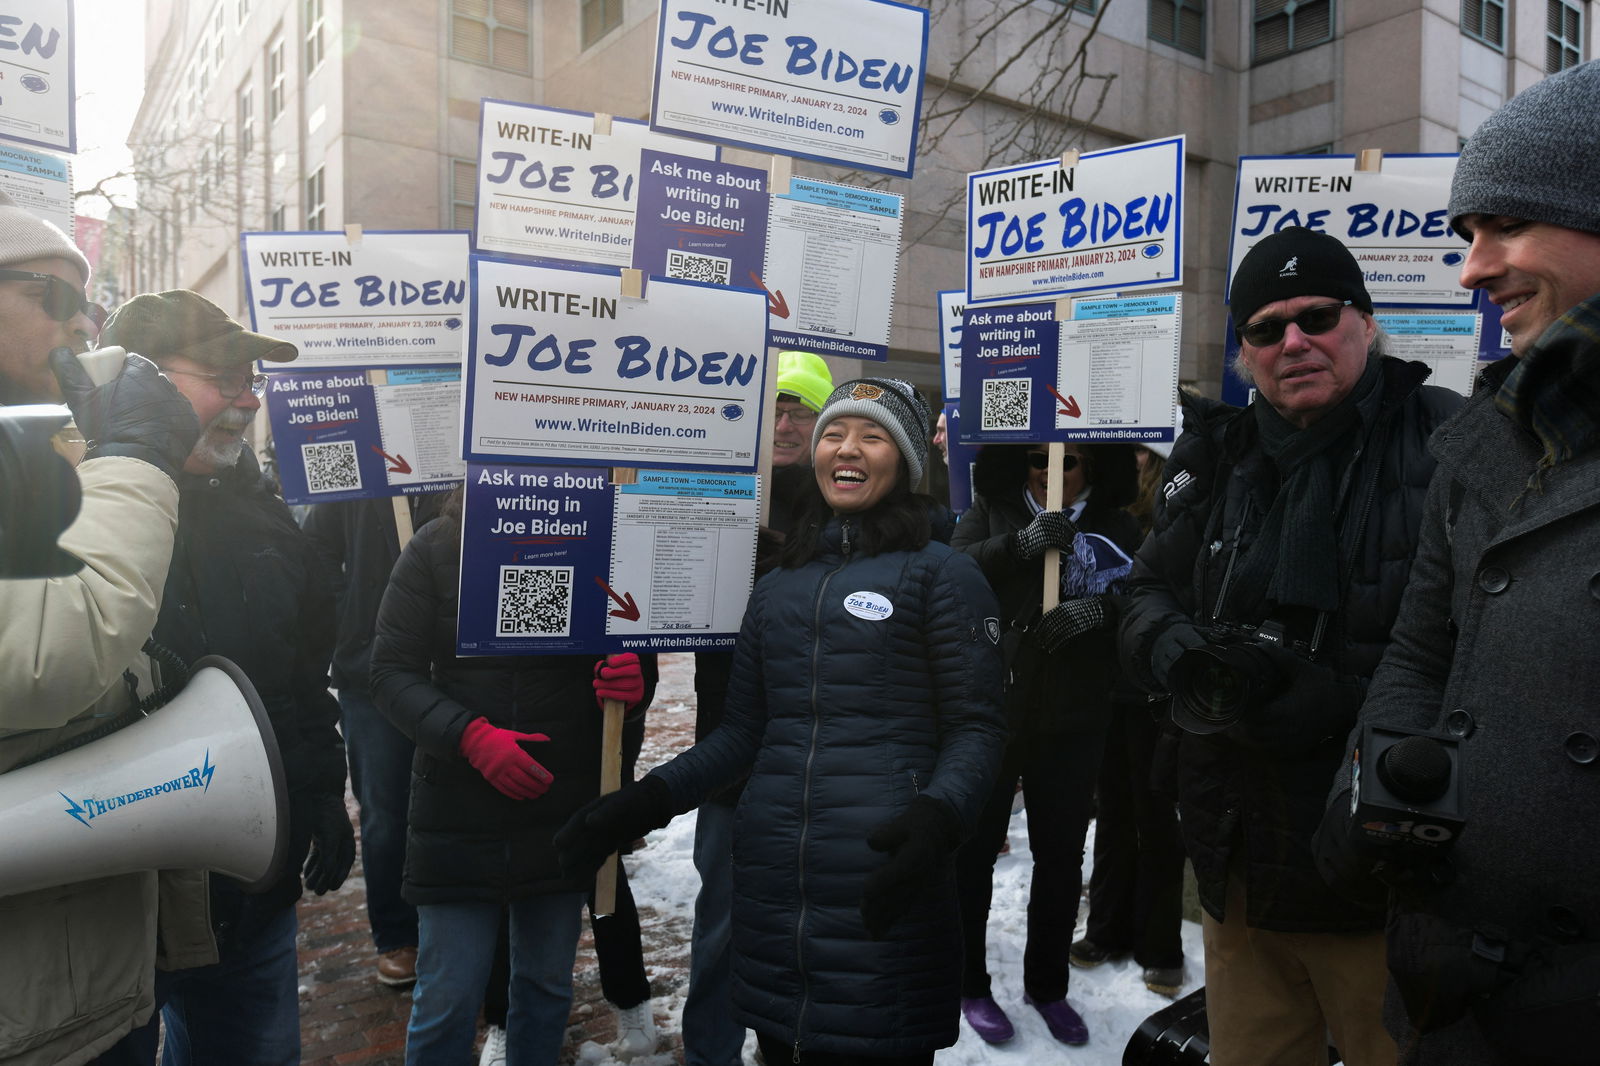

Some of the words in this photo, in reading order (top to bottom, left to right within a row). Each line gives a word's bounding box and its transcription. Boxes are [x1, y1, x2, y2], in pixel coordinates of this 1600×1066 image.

[671, 11, 769, 65] JOE
[785, 36, 913, 94] BIDEN
[671, 70, 692, 83] NEW
[694, 74, 746, 93] HAMPSHIRE
[748, 86, 789, 103] PRIMARY,
[791, 95, 831, 111] JANUARY
[833, 103, 846, 115] 23,
[848, 106, 868, 117] 2024
[712, 101, 865, 139] www.WriteInBiden.com
[498, 121, 592, 150] WRITE-IN
[0, 150, 42, 164] MOCRATIC
[487, 152, 574, 193] JOE
[651, 160, 682, 178] Ask
[687, 168, 712, 183] me
[716, 173, 761, 192] about
[979, 168, 1074, 206] WRITE-IN
[1255, 176, 1352, 193] WRITE-IN
[666, 185, 720, 210] writing
[726, 194, 740, 209] in
[490, 202, 509, 212] NEW
[510, 204, 557, 217] HAMPSHIRE
[559, 210, 596, 223] PRIMARY,
[598, 215, 634, 227] JANUARY
[661, 206, 691, 222] Joe
[695, 210, 745, 232] Biden!
[870, 205, 897, 216] SAMPLE
[1241, 204, 1331, 236] JOE
[1347, 203, 1454, 238] BIDE
[975, 212, 1046, 258] JOE
[1059, 193, 1173, 249] BIDEN
[261, 251, 352, 267] WRITE-IN
[980, 267, 995, 279] NEW
[996, 261, 1036, 277] HAMPSHIRE
[1037, 258, 1070, 274] PRIMARY,
[1072, 254, 1104, 268] JANUARY
[1106, 253, 1117, 265] 23,
[1118, 250, 1136, 262] 2024
[1357, 254, 1396, 262] JANUARY
[1399, 255, 1411, 263] 23,
[1032, 270, 1105, 286] www.WriteInBiden.com
[260, 278, 341, 308] JOE
[355, 275, 466, 307] BIDEN
[496, 286, 617, 320] WRITE-IN
[293, 323, 338, 331] HAMPSHIRE
[339, 322, 376, 330] PRIMARY,
[413, 321, 423, 330] 23,
[969, 312, 993, 326] Ask
[995, 313, 1015, 324] me
[1018, 310, 1052, 322] about
[304, 336, 436, 348] www.WriteInBiden.com
[773, 334, 876, 356] www.WriteInBiden.com
[980, 329, 1021, 342] writing
[1024, 328, 1036, 339] in
[485, 324, 597, 374] JOE
[614, 336, 758, 387] BIDEN
[977, 346, 999, 359] Joe
[1002, 344, 1041, 357] Biden!
[273, 379, 299, 393] Ask
[303, 380, 323, 391] me
[327, 376, 365, 389] about
[288, 394, 335, 408] writing
[338, 394, 350, 404] in
[495, 392, 519, 402] NEW
[521, 393, 580, 406] HAMPSHIRE
[583, 398, 629, 411] PRIMARY,
[631, 401, 675, 413] JANUARY
[678, 404, 692, 415] 23,
[693, 405, 716, 415] 2024
[289, 412, 313, 425] Joe
[317, 408, 359, 423] Biden!
[535, 418, 707, 439] www.WriteInBiden.com
[1068, 430, 1162, 440] www.WriteInBiden.com
[478, 469, 515, 486] Ask
[520, 474, 548, 488] me
[554, 473, 604, 490] about
[643, 476, 669, 484] SAMPLE
[697, 479, 737, 487] DEMOCRATIC
[724, 489, 753, 497] SAMPLE
[496, 496, 558, 516] writing
[565, 497, 581, 513] in
[491, 519, 526, 535] Joe
[532, 520, 587, 536] Biden!
[848, 599, 865, 607] JOE
[866, 601, 889, 614] BIDEN
[623, 638, 736, 648] www.WriteInBiden.com
[1259, 632, 1279, 642] SONY
[83, 767, 203, 820] THUNDERPOWER
